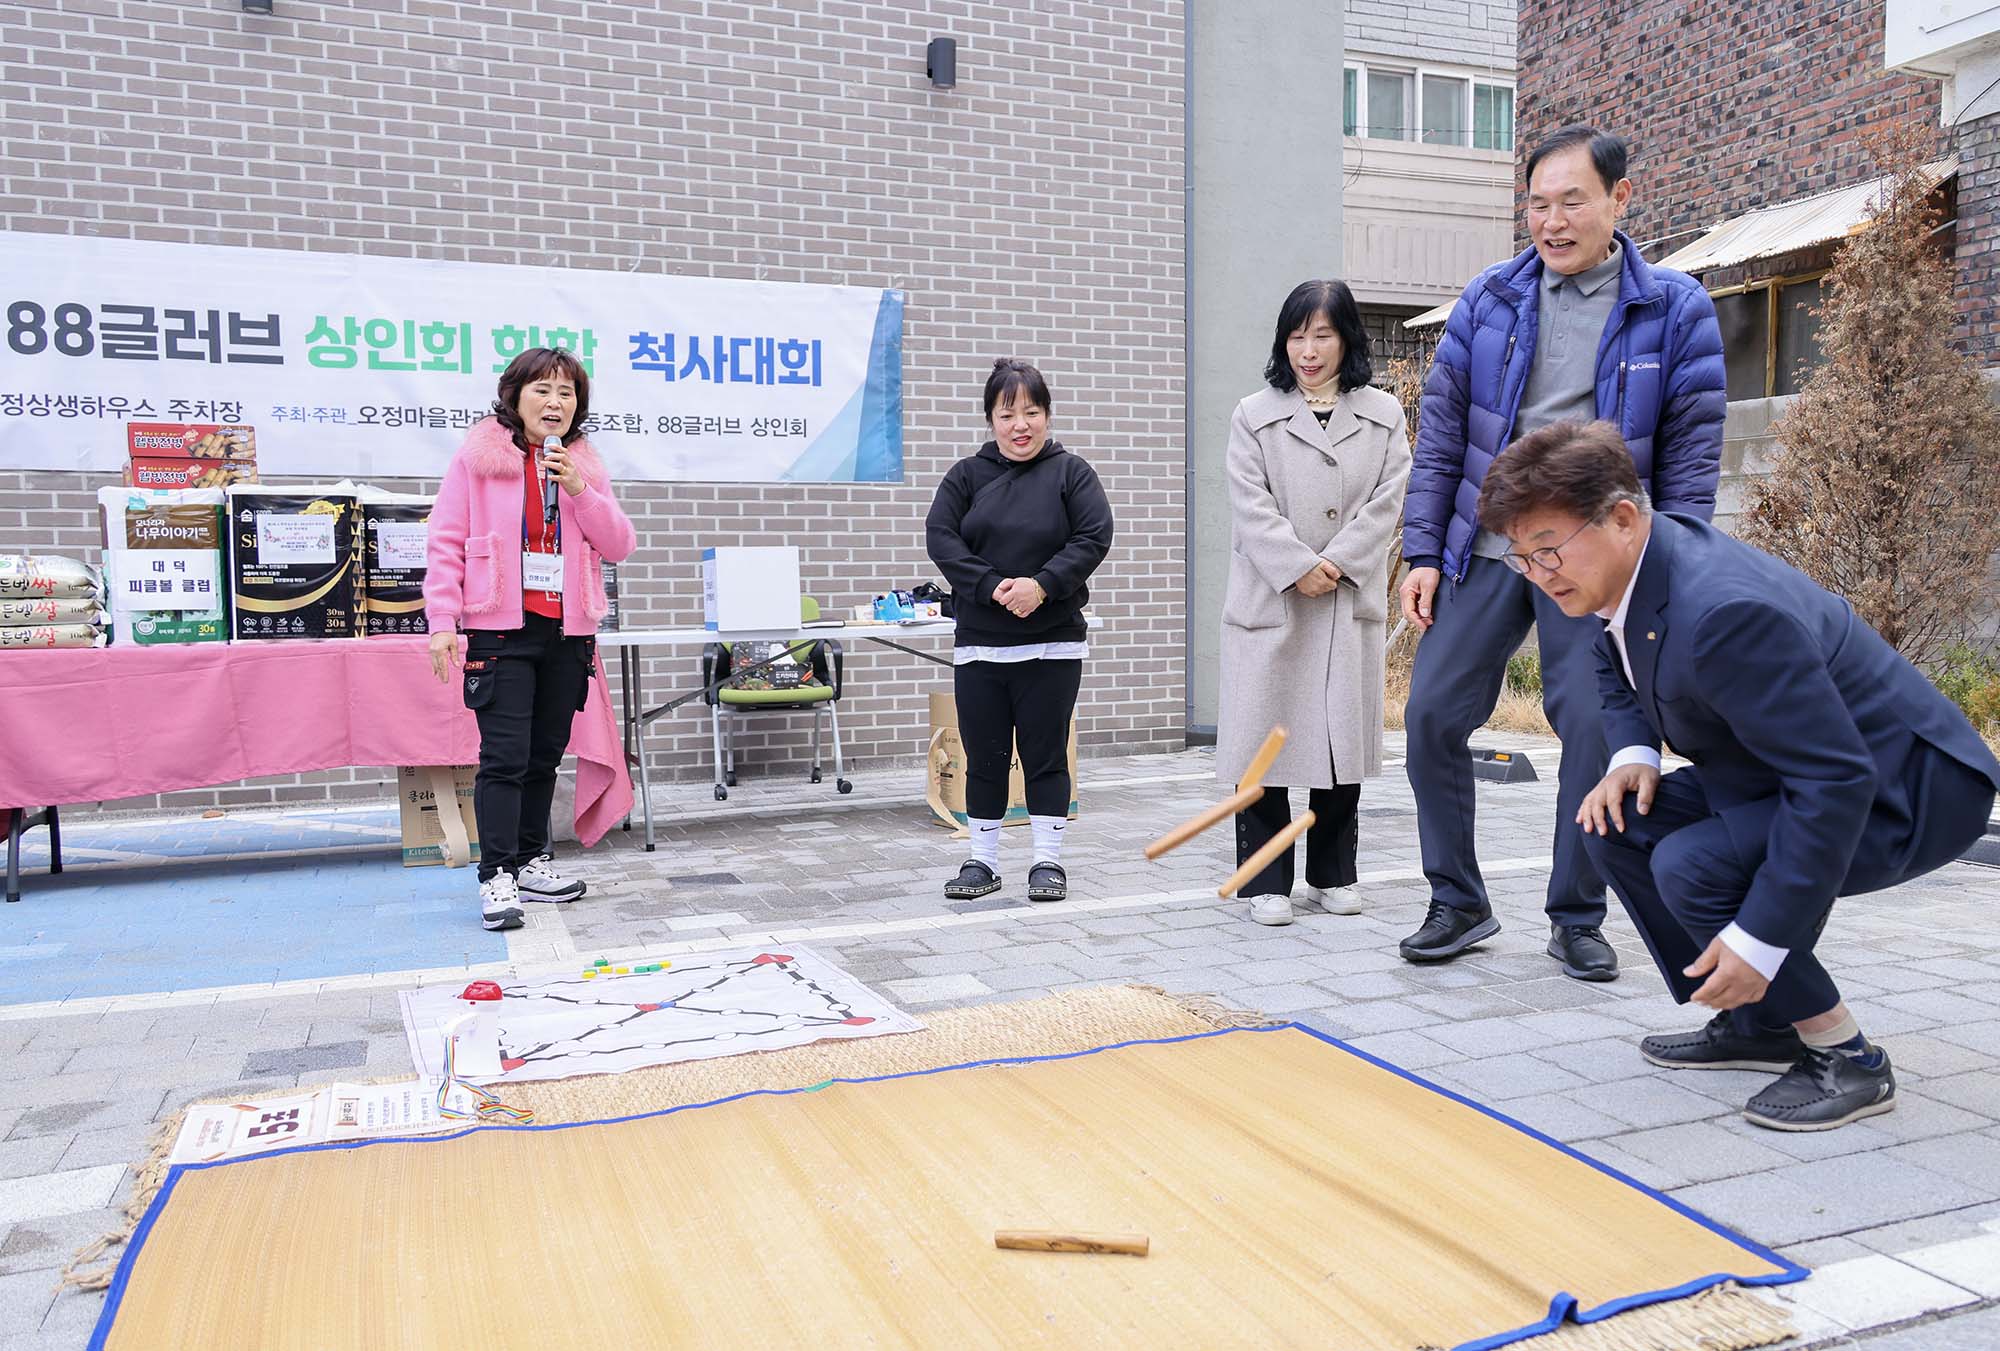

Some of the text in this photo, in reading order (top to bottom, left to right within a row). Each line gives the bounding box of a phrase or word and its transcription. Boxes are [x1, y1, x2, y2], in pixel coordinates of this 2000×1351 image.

[7, 301, 284, 365] 88글러브
[305, 316, 472, 374] 상인회
[629, 331, 822, 387] 척사대회
[168, 400, 243, 424] 주차장
[658, 416, 743, 437] 88글러브
[751, 418, 808, 438] 상인회
[135, 527, 199, 540] 나무이야기
[129, 579, 211, 593] 피클볼 클럽
[247, 1107, 300, 1139] 5조
